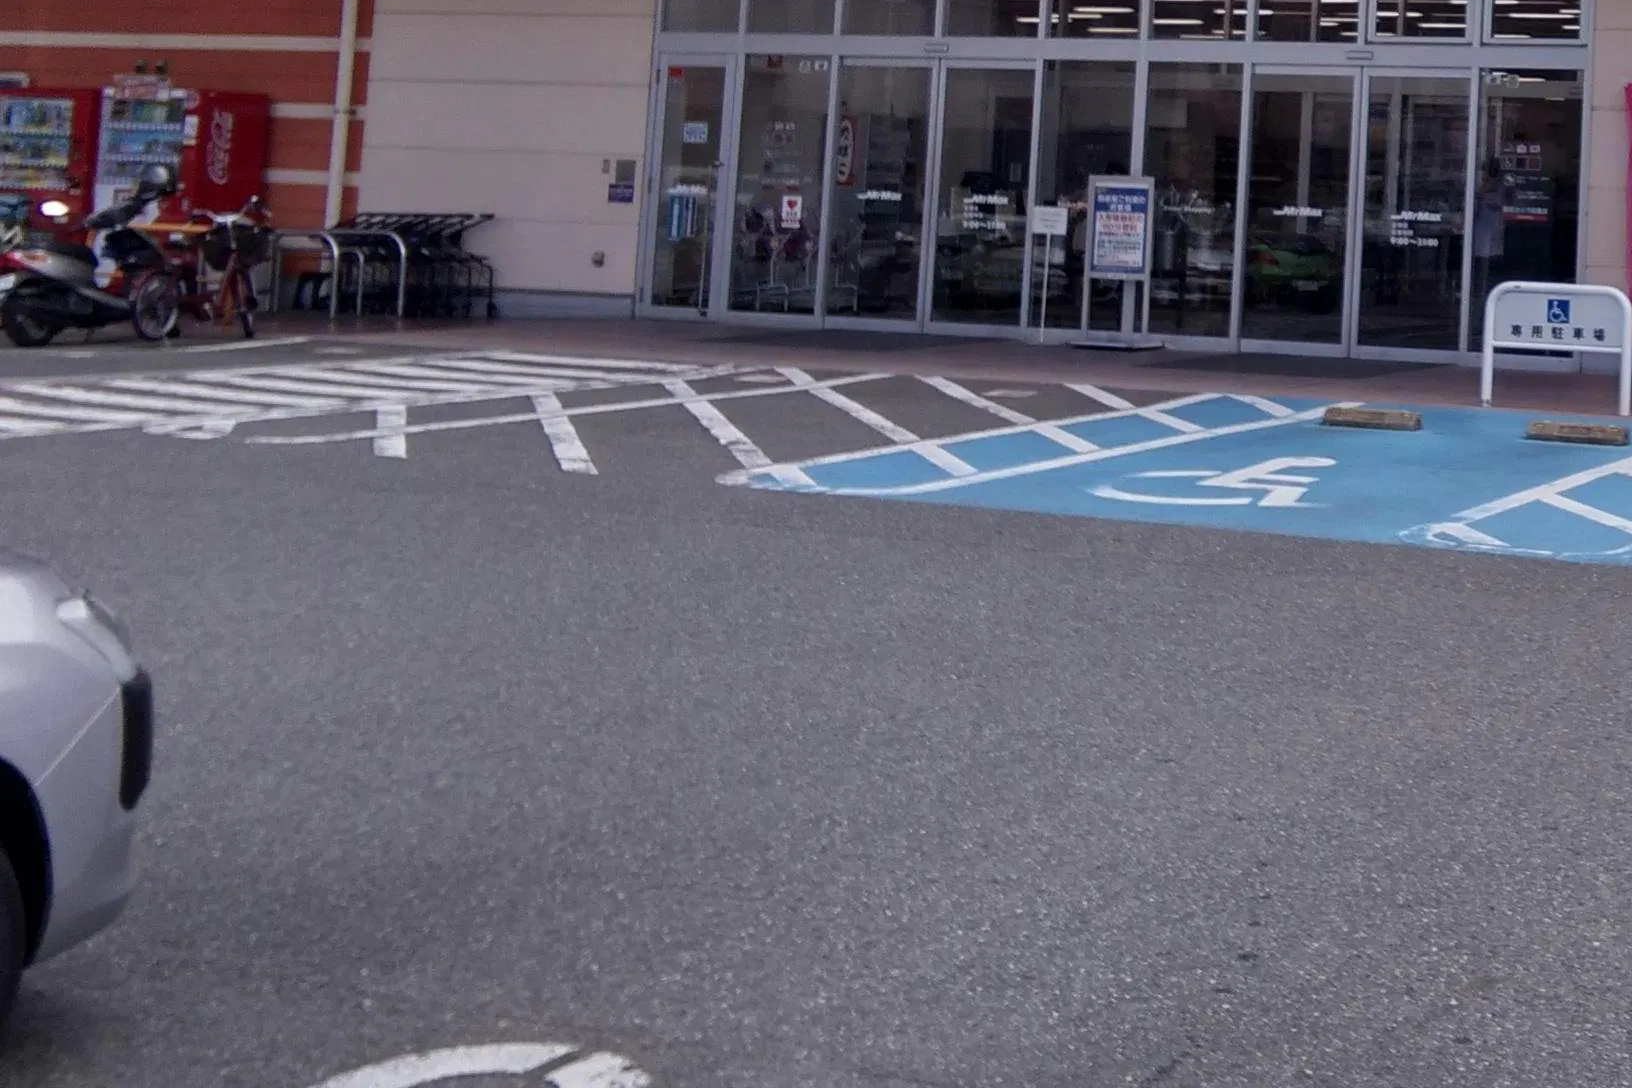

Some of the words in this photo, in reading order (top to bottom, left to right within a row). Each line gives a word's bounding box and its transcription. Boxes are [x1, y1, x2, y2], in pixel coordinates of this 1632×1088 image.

[1510, 324, 1605, 342] 専用駐車場
